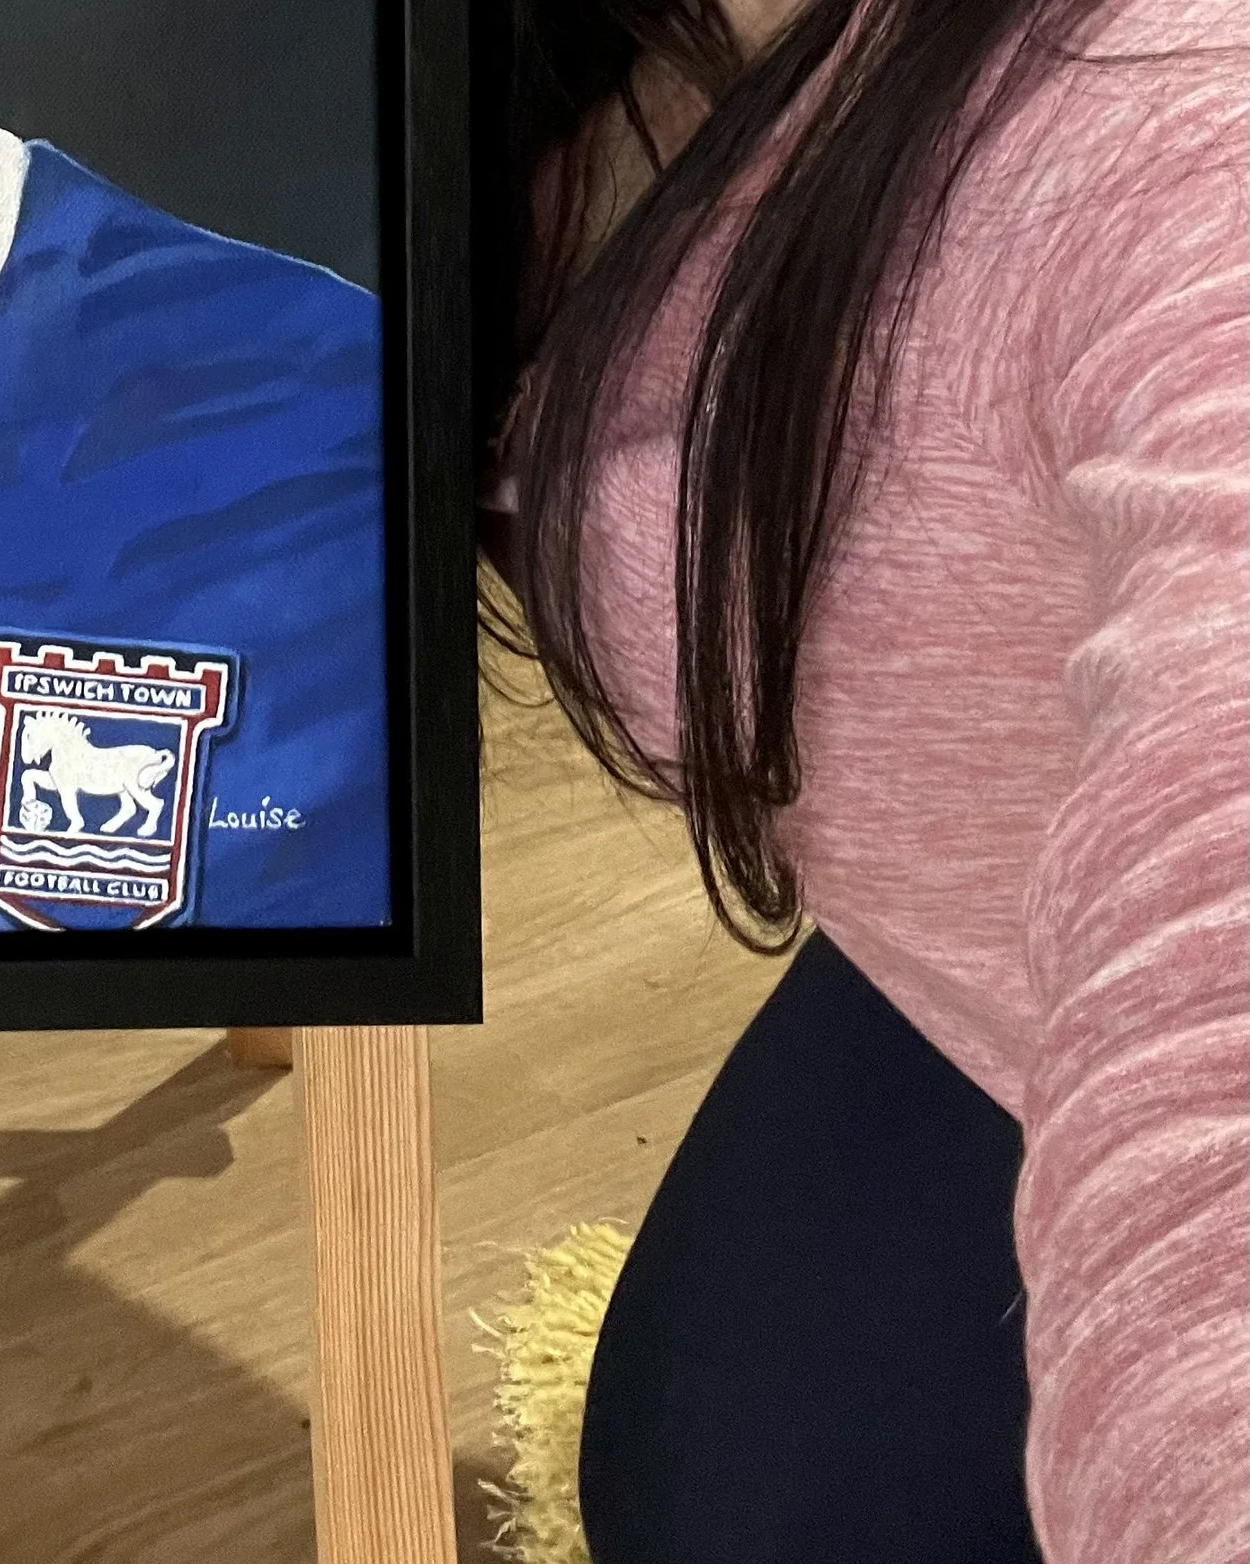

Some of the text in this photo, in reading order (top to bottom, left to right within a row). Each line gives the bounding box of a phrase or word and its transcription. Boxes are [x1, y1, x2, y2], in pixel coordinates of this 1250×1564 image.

[14, 672, 192, 708] IPSWICH TOWN
[208, 796, 306, 831] Louise
[3, 871, 159, 900] FOOTBALL CLUB
